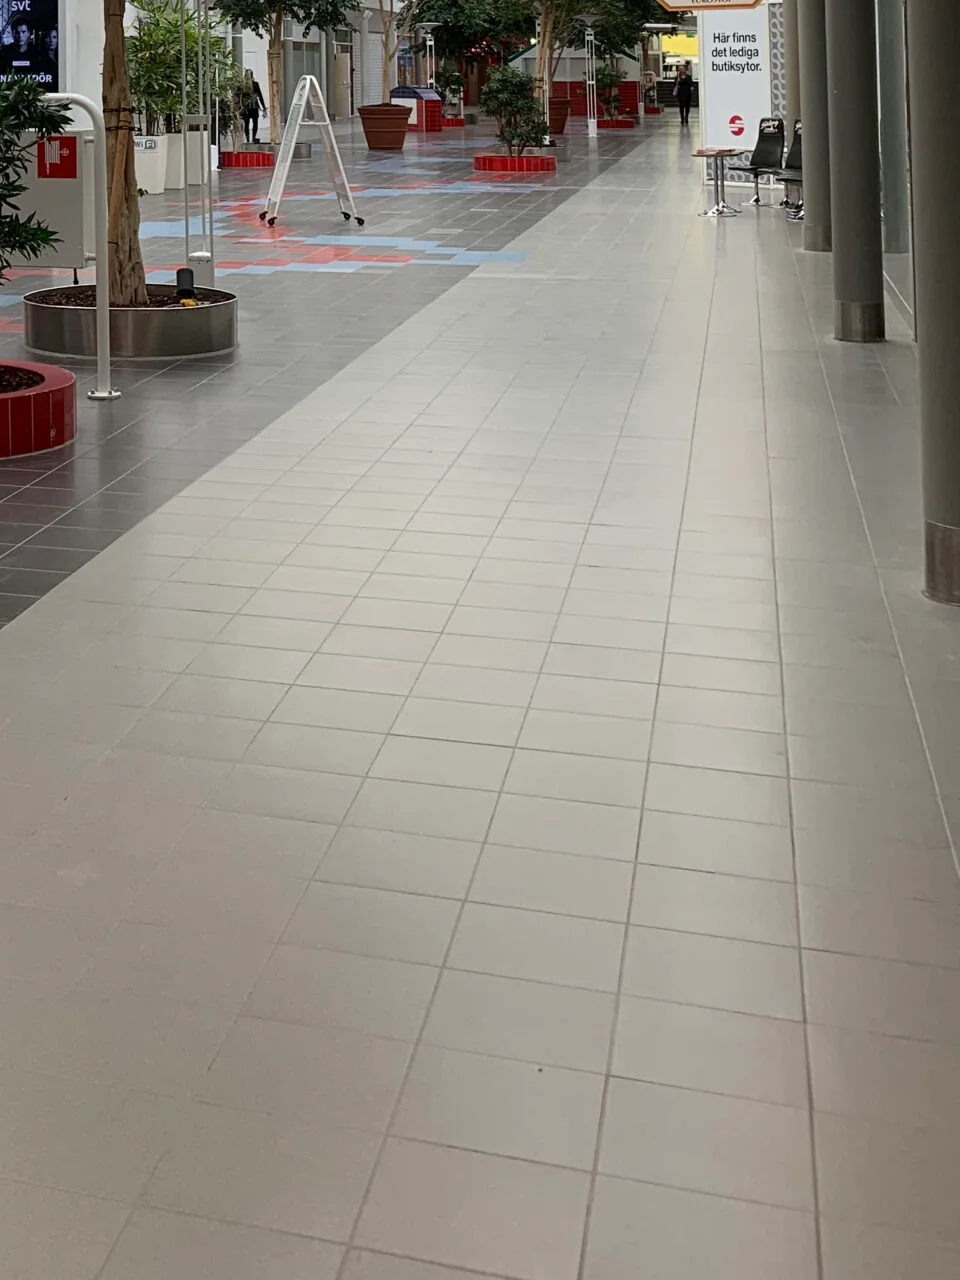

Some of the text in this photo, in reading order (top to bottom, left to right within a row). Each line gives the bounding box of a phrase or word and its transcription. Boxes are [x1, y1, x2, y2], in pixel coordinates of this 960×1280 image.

[713, 32, 757, 43] Här finns
[711, 46, 759, 60] det lediga
[711, 61, 762, 74] butiksytor.
